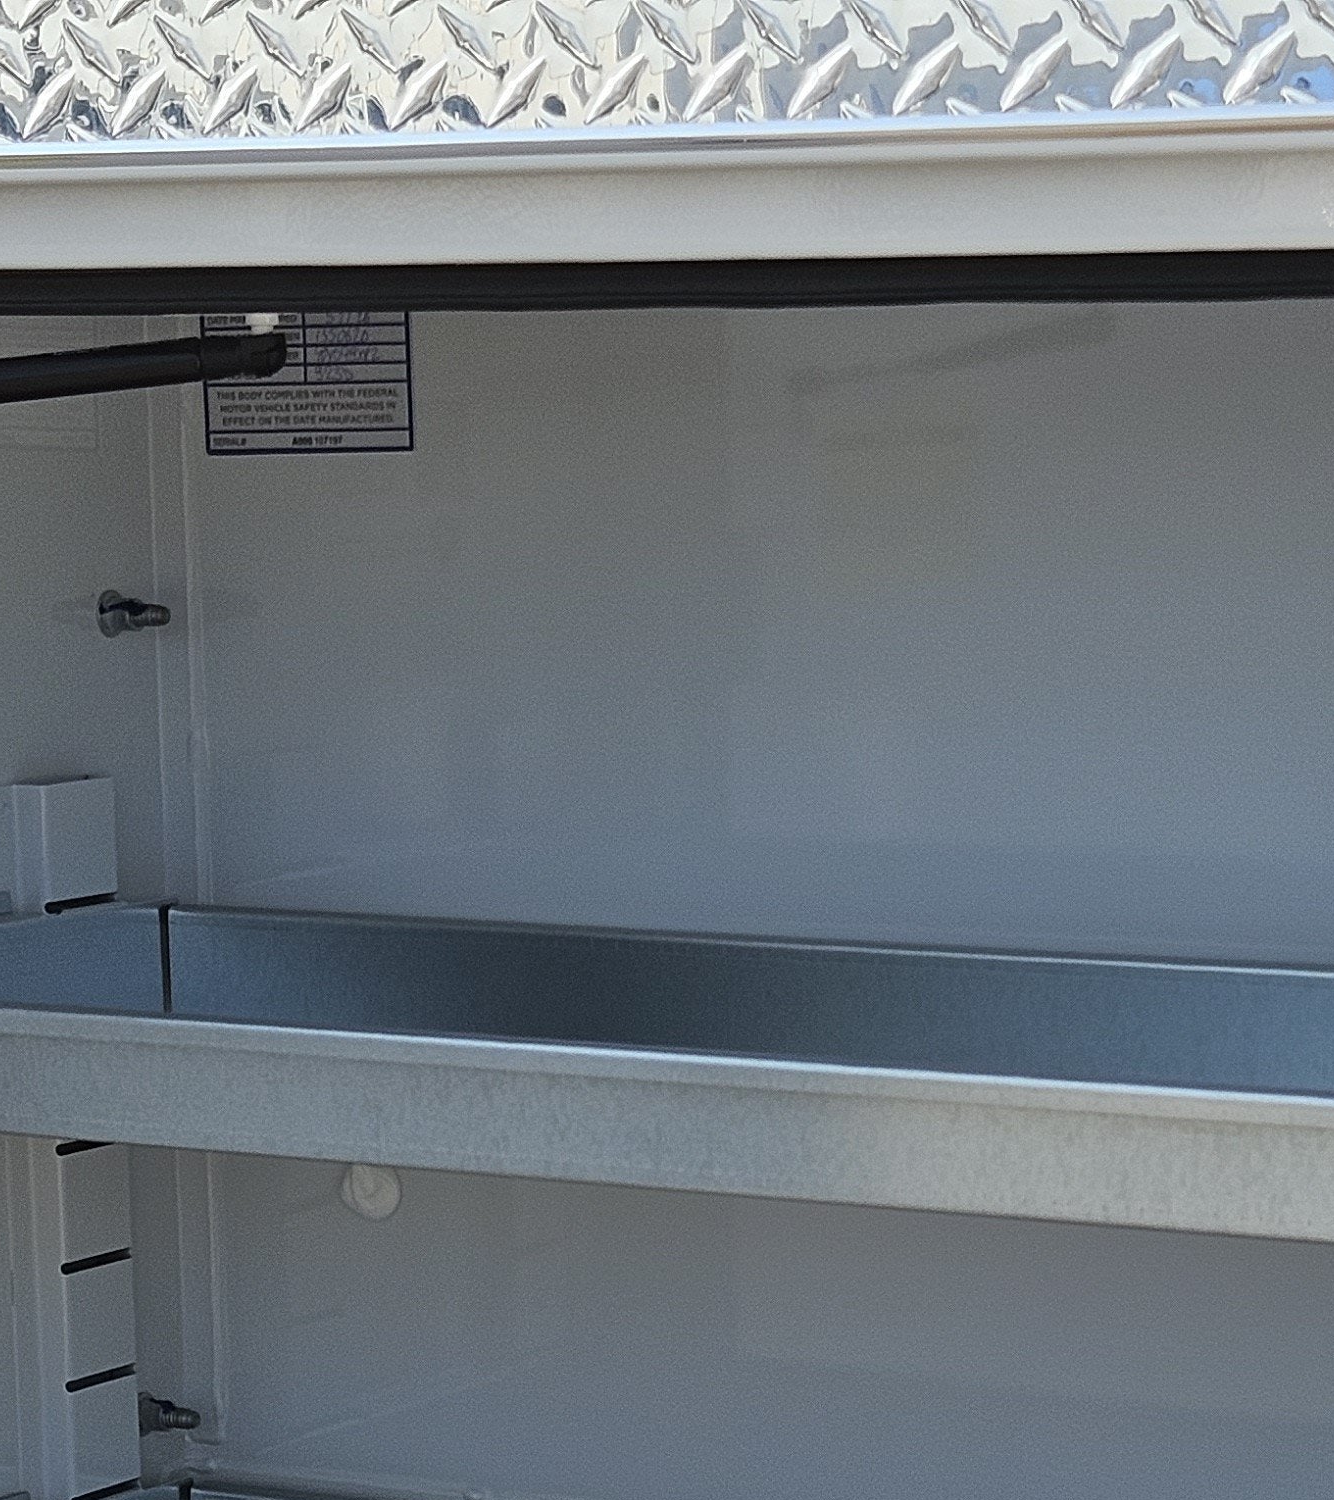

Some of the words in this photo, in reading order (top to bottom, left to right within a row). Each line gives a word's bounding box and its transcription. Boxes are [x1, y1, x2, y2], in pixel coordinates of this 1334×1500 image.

[265, 389, 309, 400] COMPLIES
[312, 389, 335, 399] WITH
[337, 388, 355, 398] THE
[357, 387, 398, 398] FEDERAL
[254, 403, 291, 413] VEHICLE
[293, 402, 328, 412] SAFETY
[330, 401, 384, 411] STANDARDS
[222, 416, 255, 426] EFFECT
[257, 416, 272, 426] ON
[274, 415, 291, 425] THE
[293, 414, 317, 424] DATE
